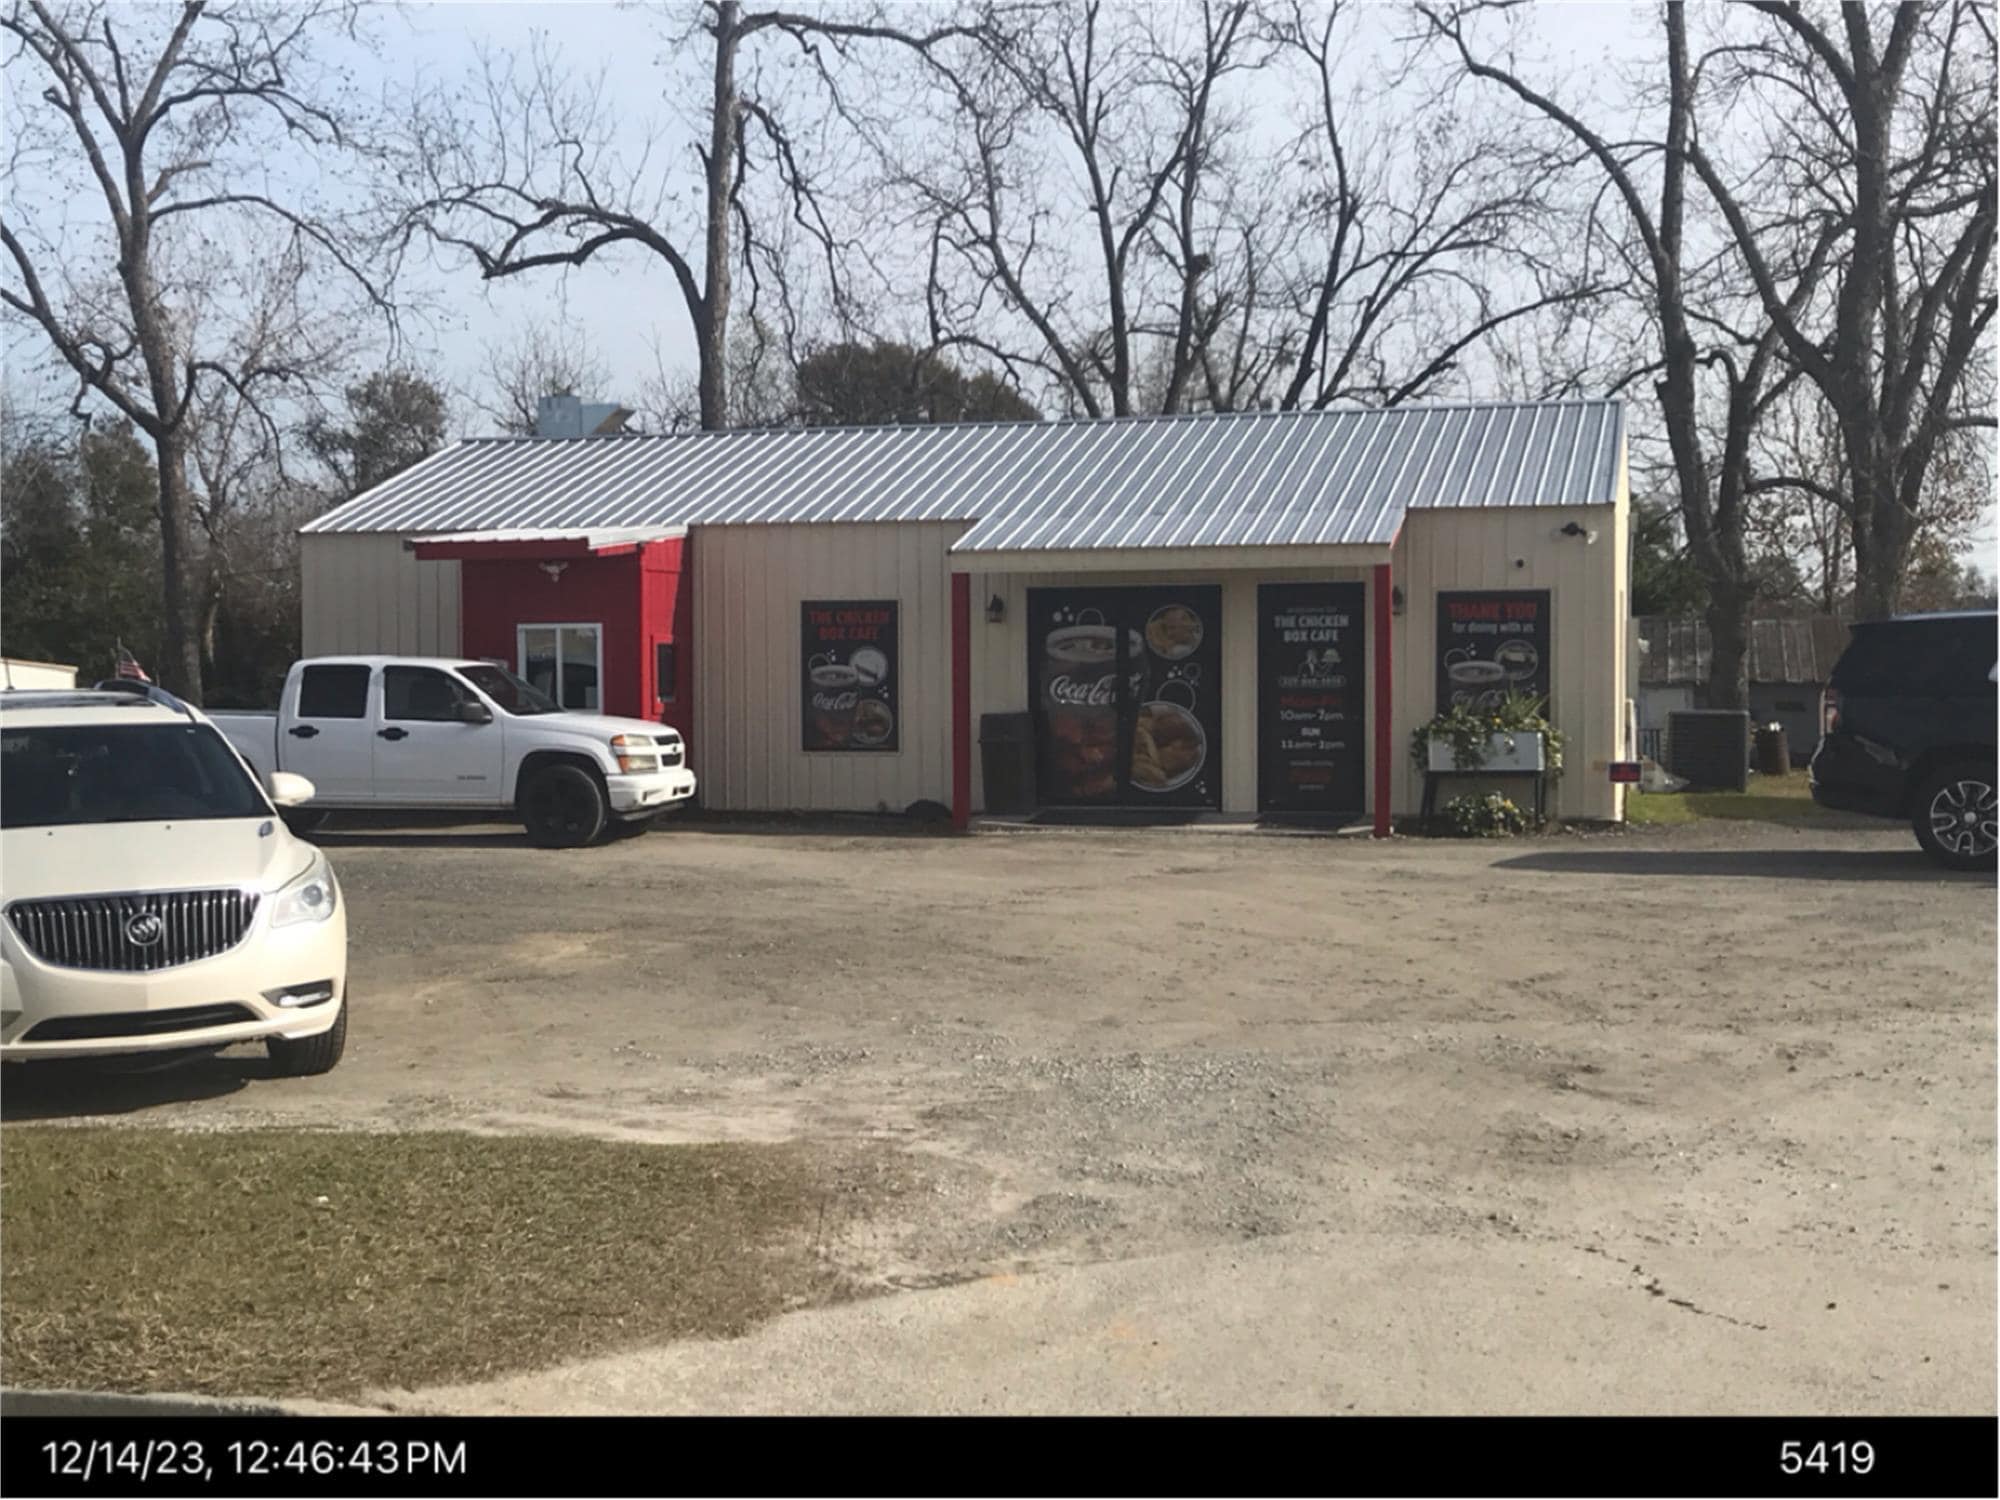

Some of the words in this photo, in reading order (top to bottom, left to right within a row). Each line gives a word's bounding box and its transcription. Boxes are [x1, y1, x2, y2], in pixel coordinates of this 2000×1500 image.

[809, 610, 832, 624] THE
[836, 610, 889, 624] CHICKEN
[1448, 601, 1499, 619] THANK
[1503, 601, 1536, 619] YOU
[1274, 615, 1296, 628] THE
[1298, 615, 1349, 628] CHICKEN
[1452, 621, 1466, 633] for
[1468, 621, 1497, 635] dining
[1500, 621, 1520, 632] with
[1522, 622, 1535, 633] us
[818, 626, 846, 640] BOX
[849, 626, 880, 640] CAFE
[1284, 629, 1308, 642] BOX
[1310, 628, 1338, 641] CAFE
